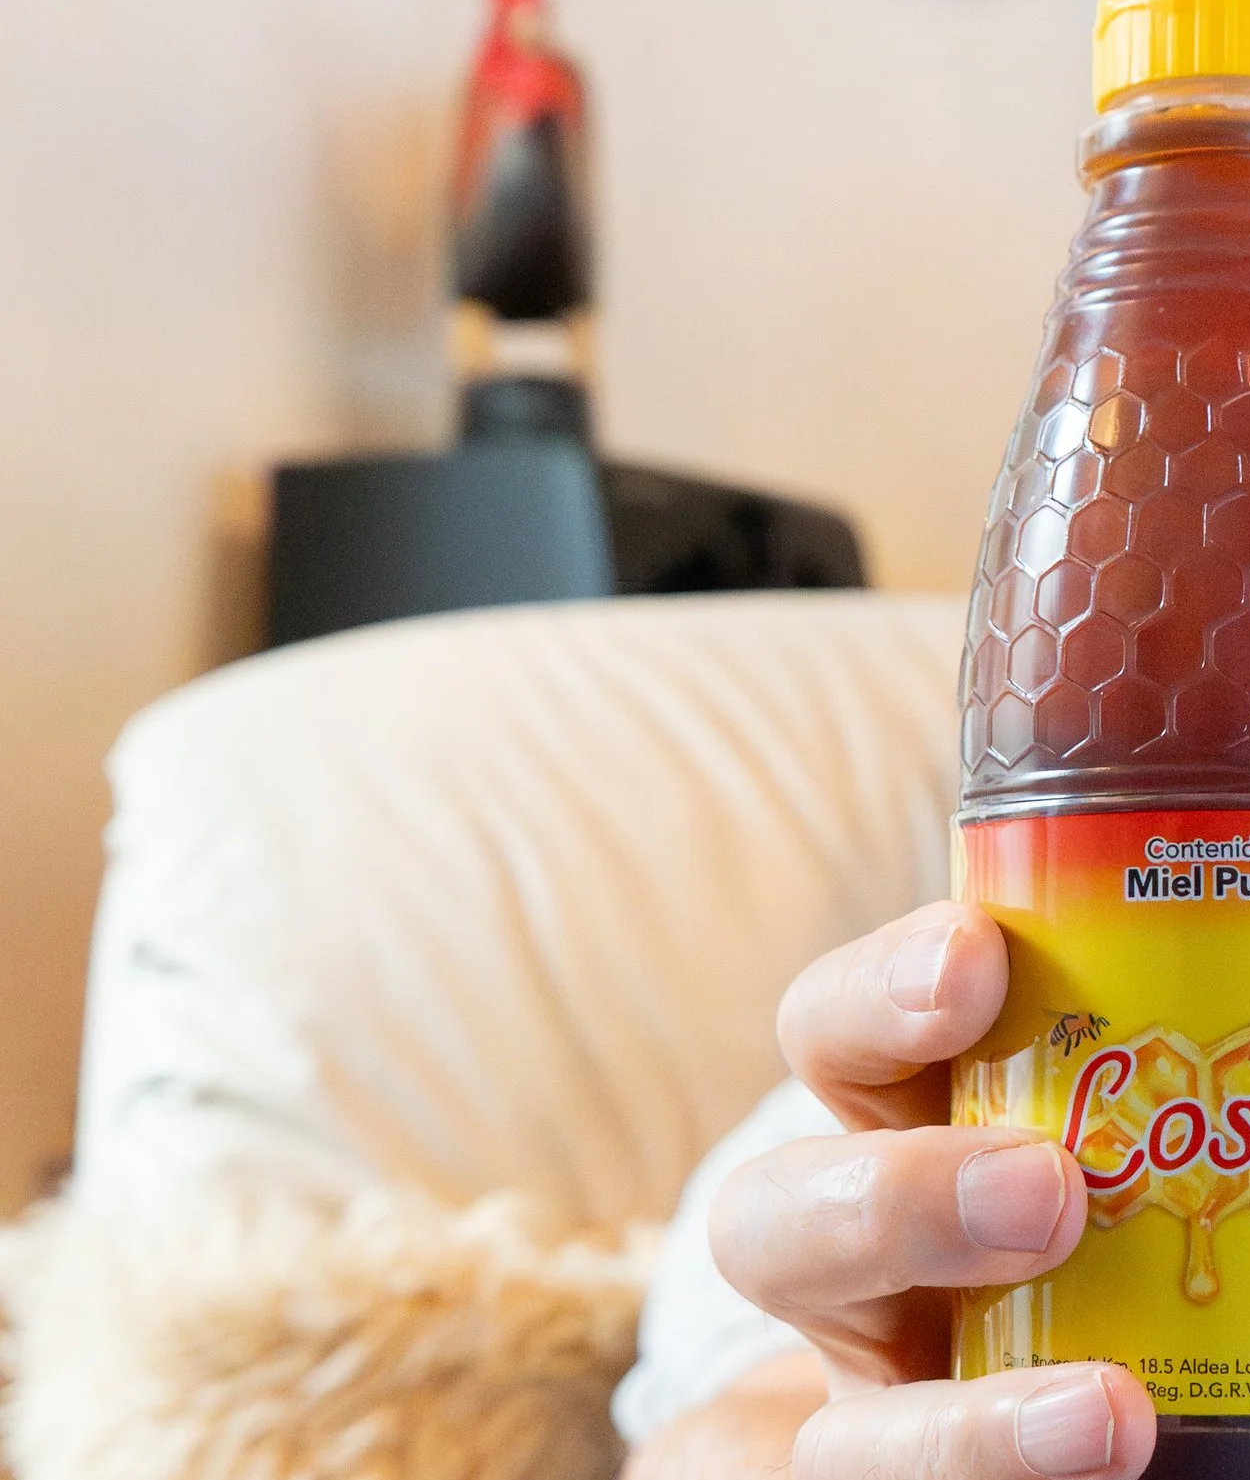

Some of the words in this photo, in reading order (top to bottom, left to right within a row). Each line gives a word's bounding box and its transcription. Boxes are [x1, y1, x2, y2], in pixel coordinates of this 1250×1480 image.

[1127, 865, 1201, 898] Miel
[1139, 1357, 1174, 1375] 18.5
[1178, 1357, 1230, 1375] Aldea
[1145, 1381, 1184, 1402] Reg.
